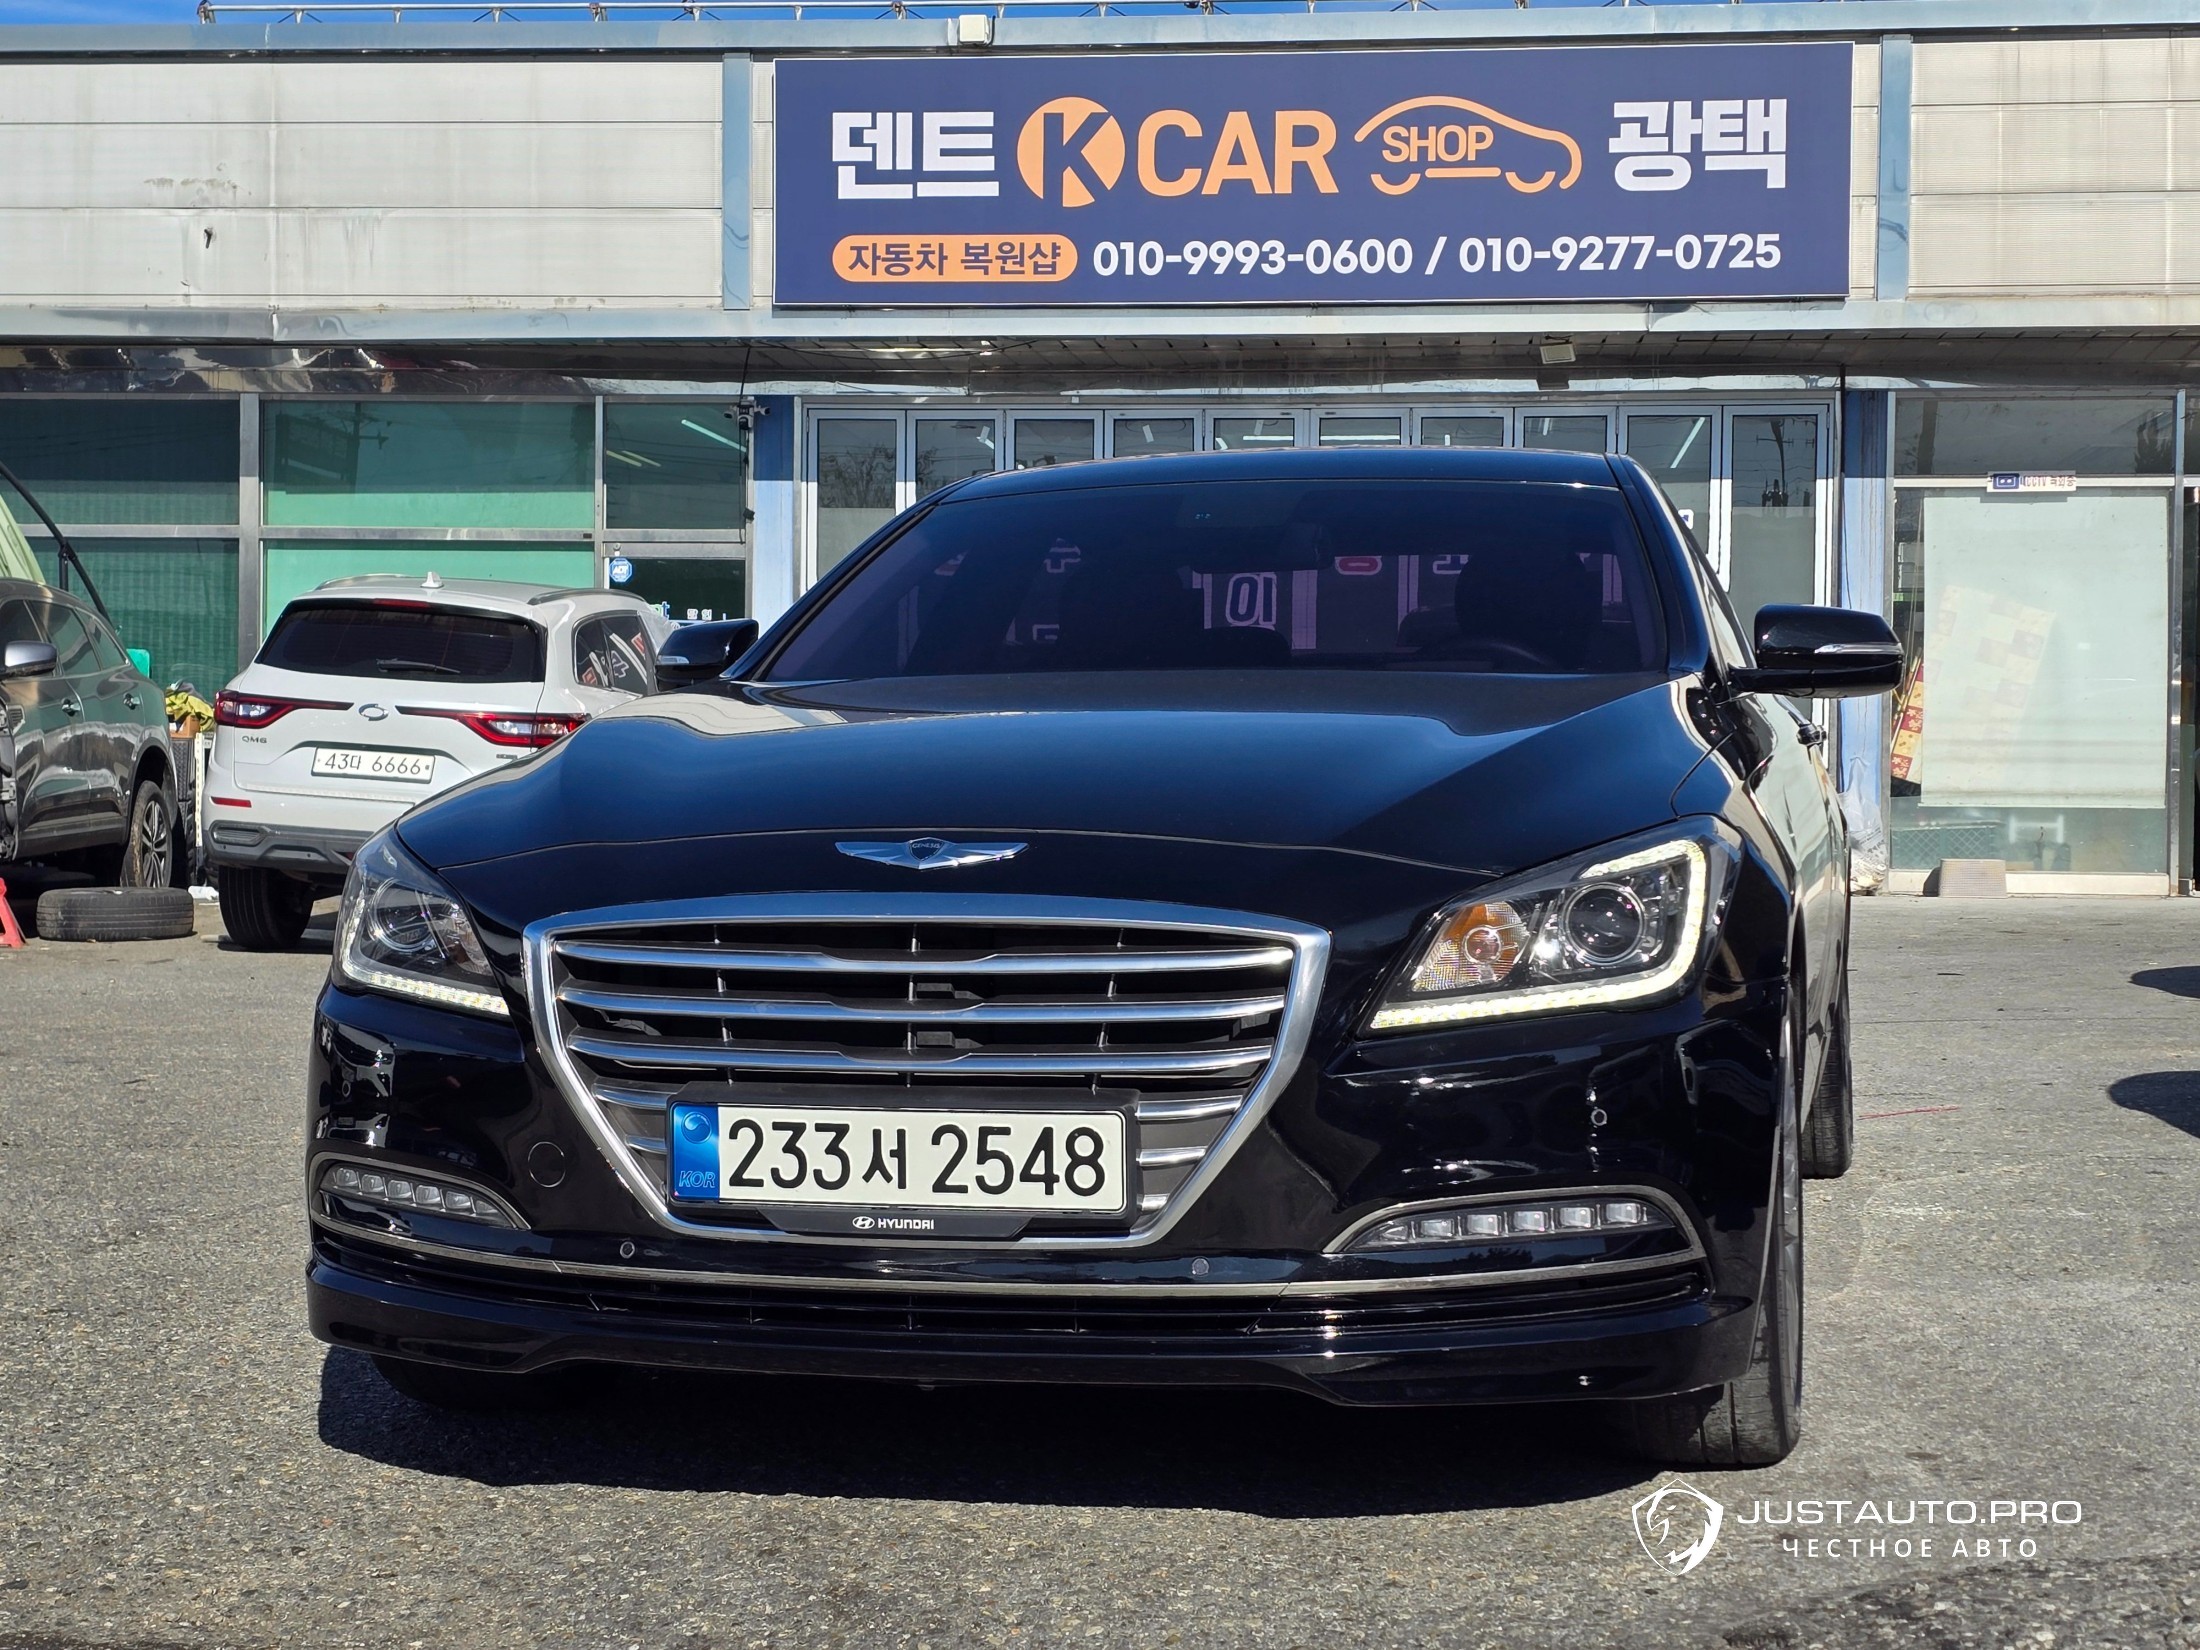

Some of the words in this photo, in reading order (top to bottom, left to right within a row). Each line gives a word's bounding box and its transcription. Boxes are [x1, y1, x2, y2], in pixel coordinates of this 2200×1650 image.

[833, 111, 999, 199] 덴트
[1382, 124, 1494, 163] SHOP
[1608, 98, 1788, 192] 광택
[849, 242, 948, 276] 자동차
[960, 241, 1061, 276] 복원샵
[1093, 239, 1413, 277] 010-9993-0600
[1459, 233, 1781, 272] 010-9277-0725
[242, 735, 268, 744] QM6
[325, 752, 362, 770] 43다
[372, 755, 421, 775] 6666
[728, 1118, 907, 1190] 233서
[931, 1125, 1105, 1198] 2548
[679, 1171, 715, 1188] KOR
[877, 1217, 935, 1230] HYUNDAI
